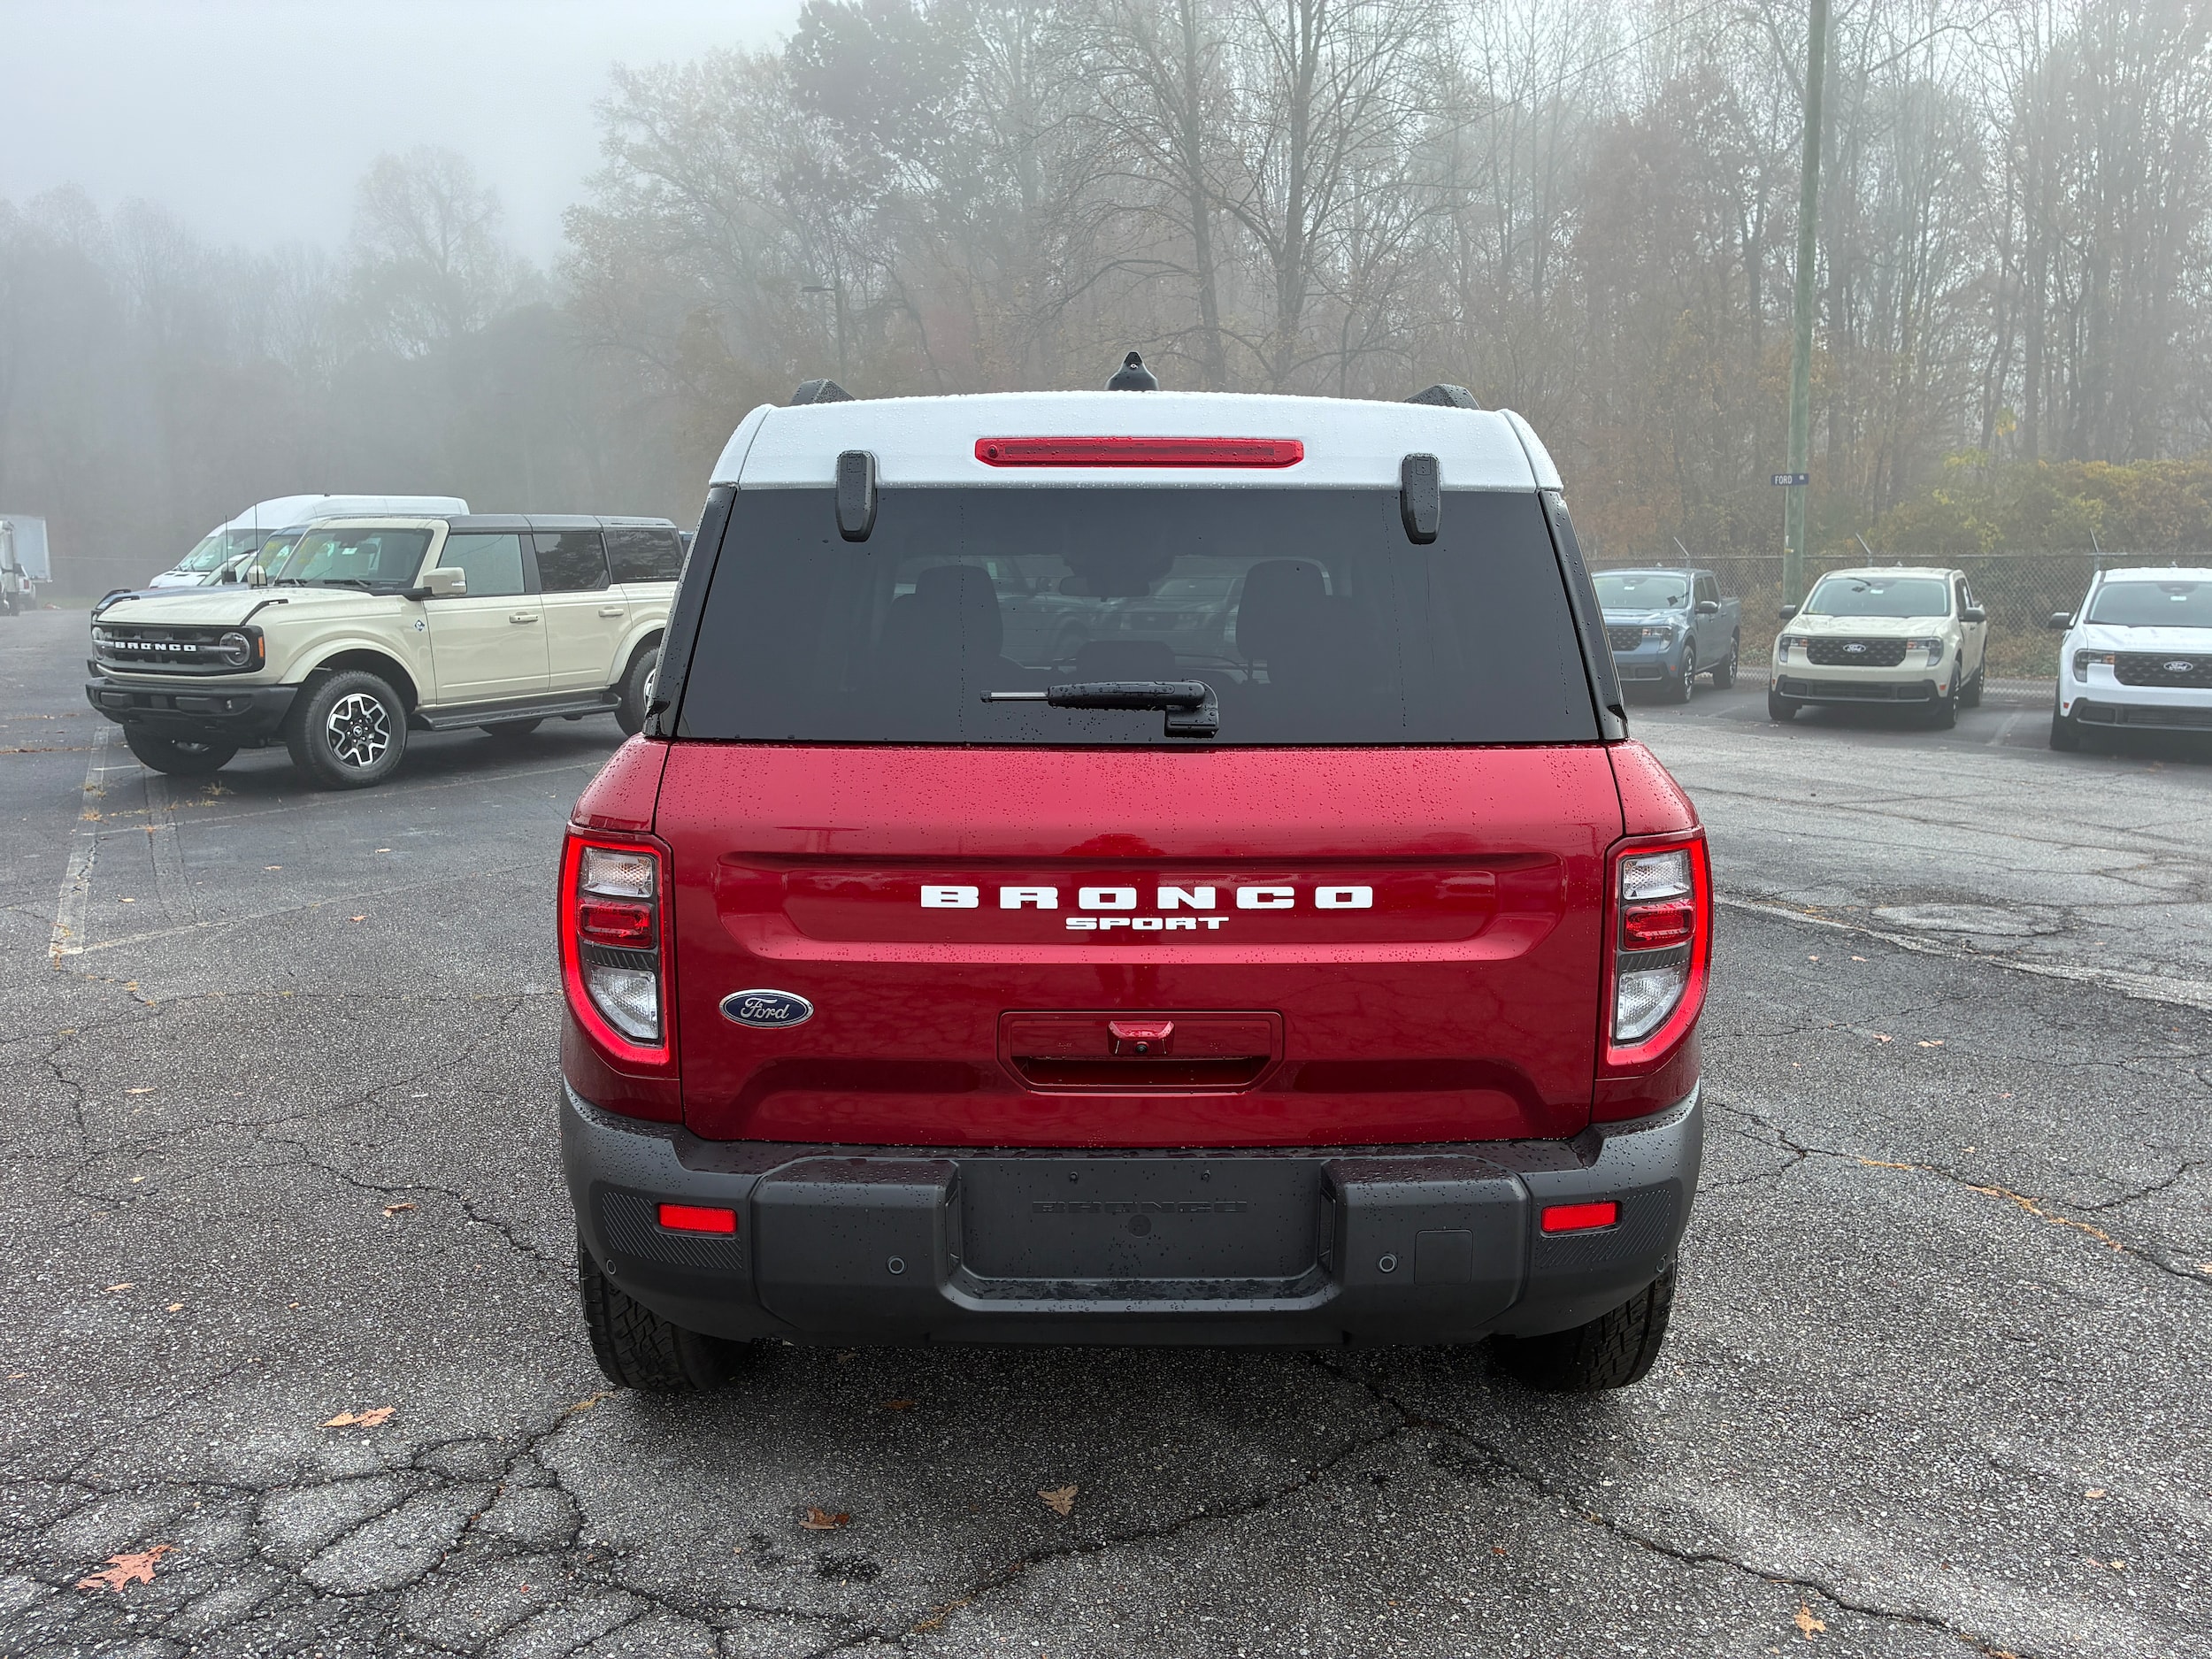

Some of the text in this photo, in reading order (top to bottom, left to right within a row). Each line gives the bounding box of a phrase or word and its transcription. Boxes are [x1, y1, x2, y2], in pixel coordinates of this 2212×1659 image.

[1774, 475, 1793, 485] FORD
[115, 641, 196, 652] BRONCO
[920, 886, 1373, 910] BRONCO
[1065, 917, 1229, 930] SPORT
[740, 997, 790, 1019] Ford
[1033, 1201, 1248, 1213] BRONCO
